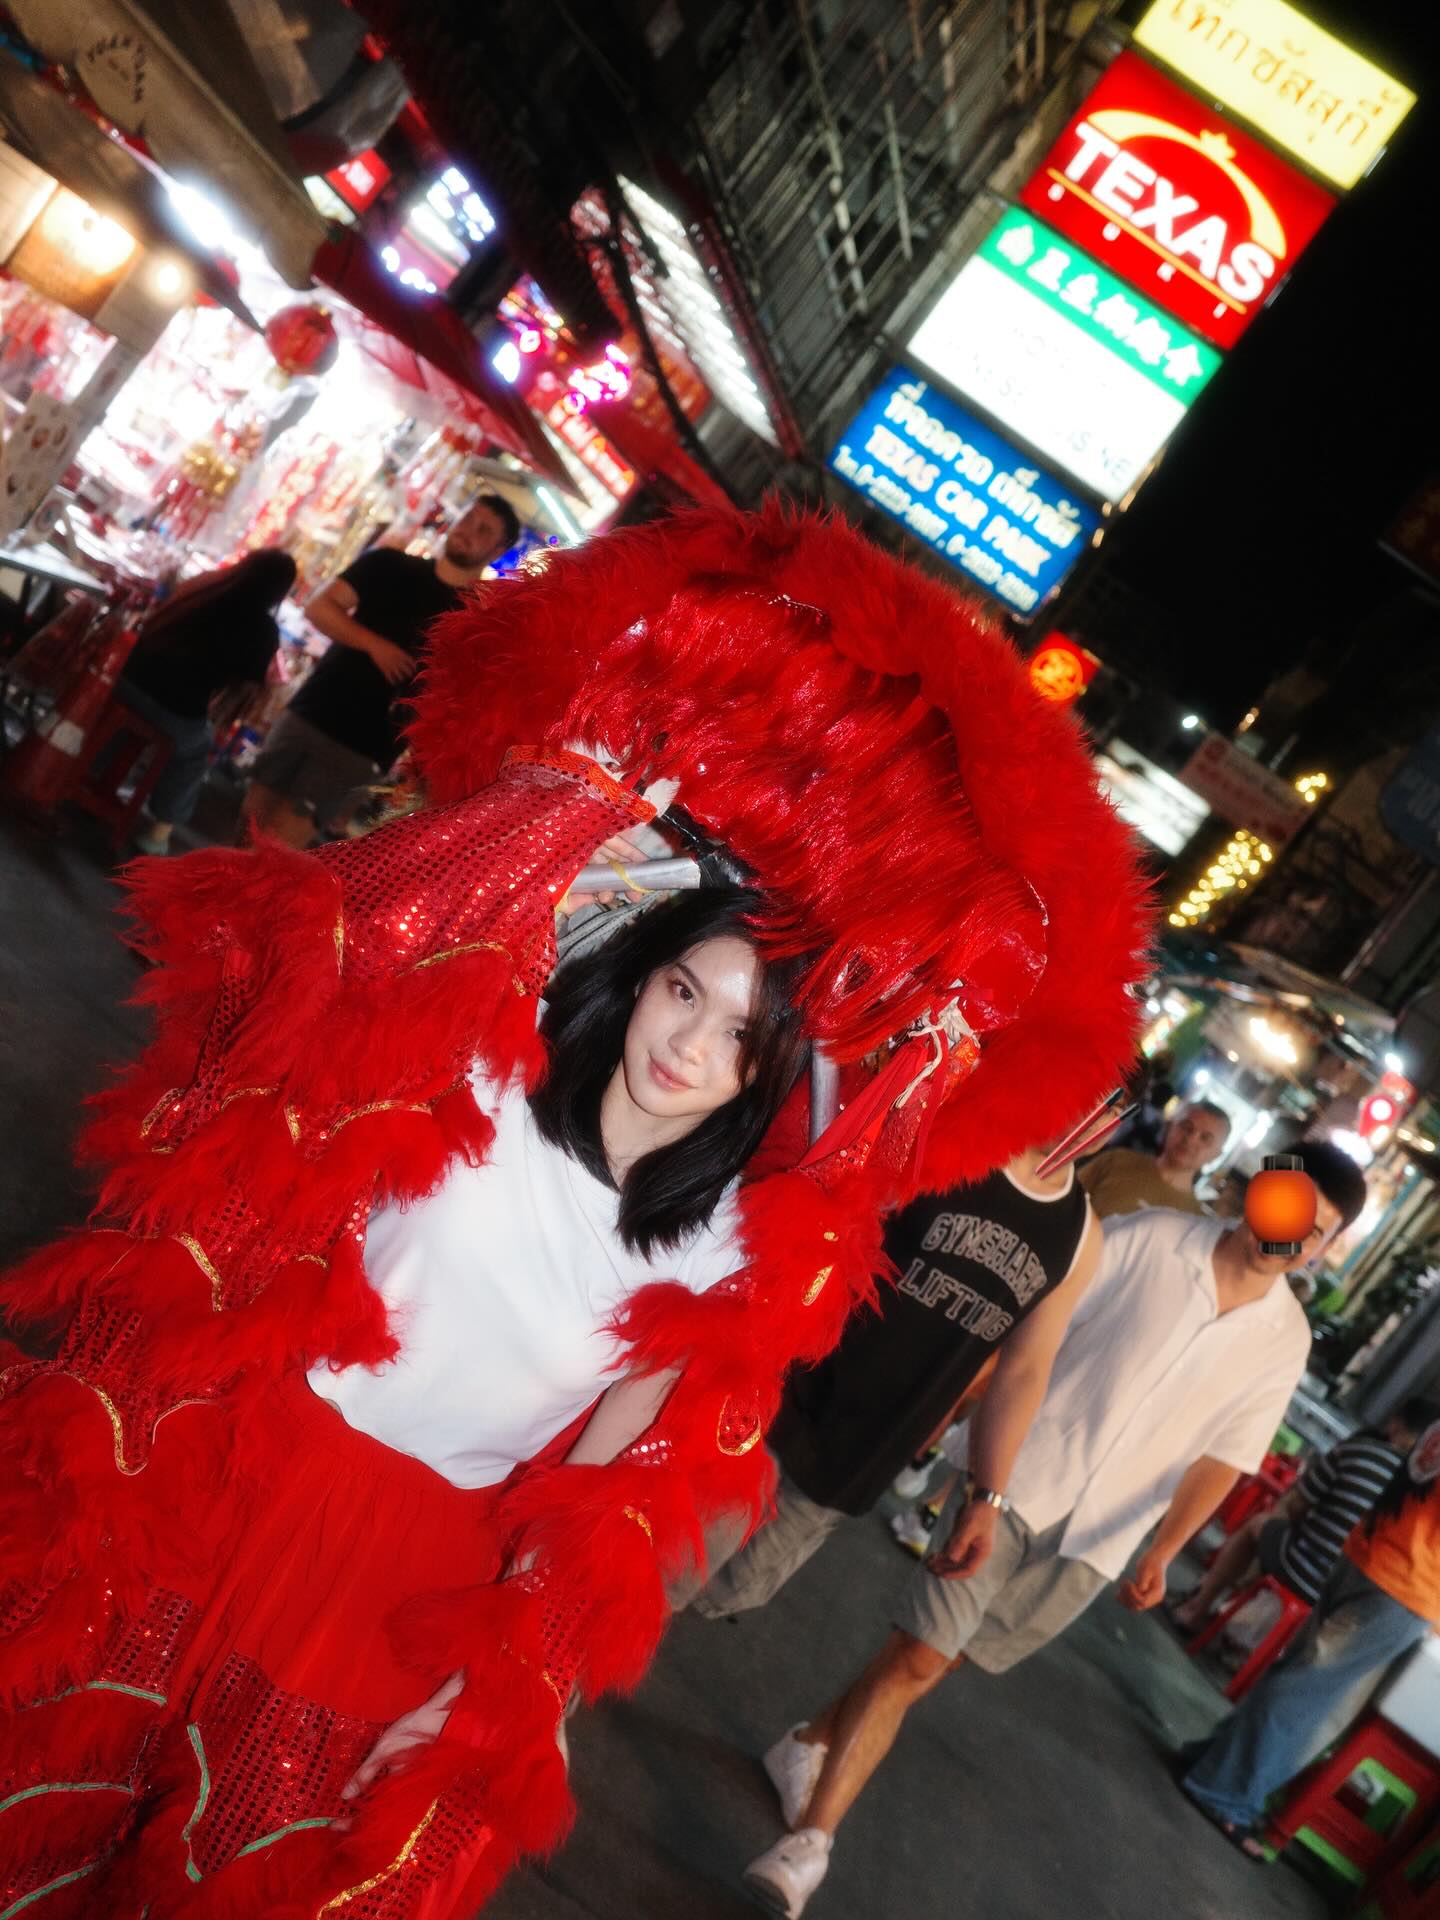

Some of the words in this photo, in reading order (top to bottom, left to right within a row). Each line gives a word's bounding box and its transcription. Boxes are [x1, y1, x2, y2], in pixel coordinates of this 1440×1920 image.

[1168, 0, 1400, 147] เทกซัสสุกี้
[1064, 121, 1276, 302] TEXAS
[864, 424, 941, 492] TEXAS
[935, 480, 989, 531] CAR
[981, 515, 1052, 578] PARK
[897, 1257, 1014, 1342] LIFTING
